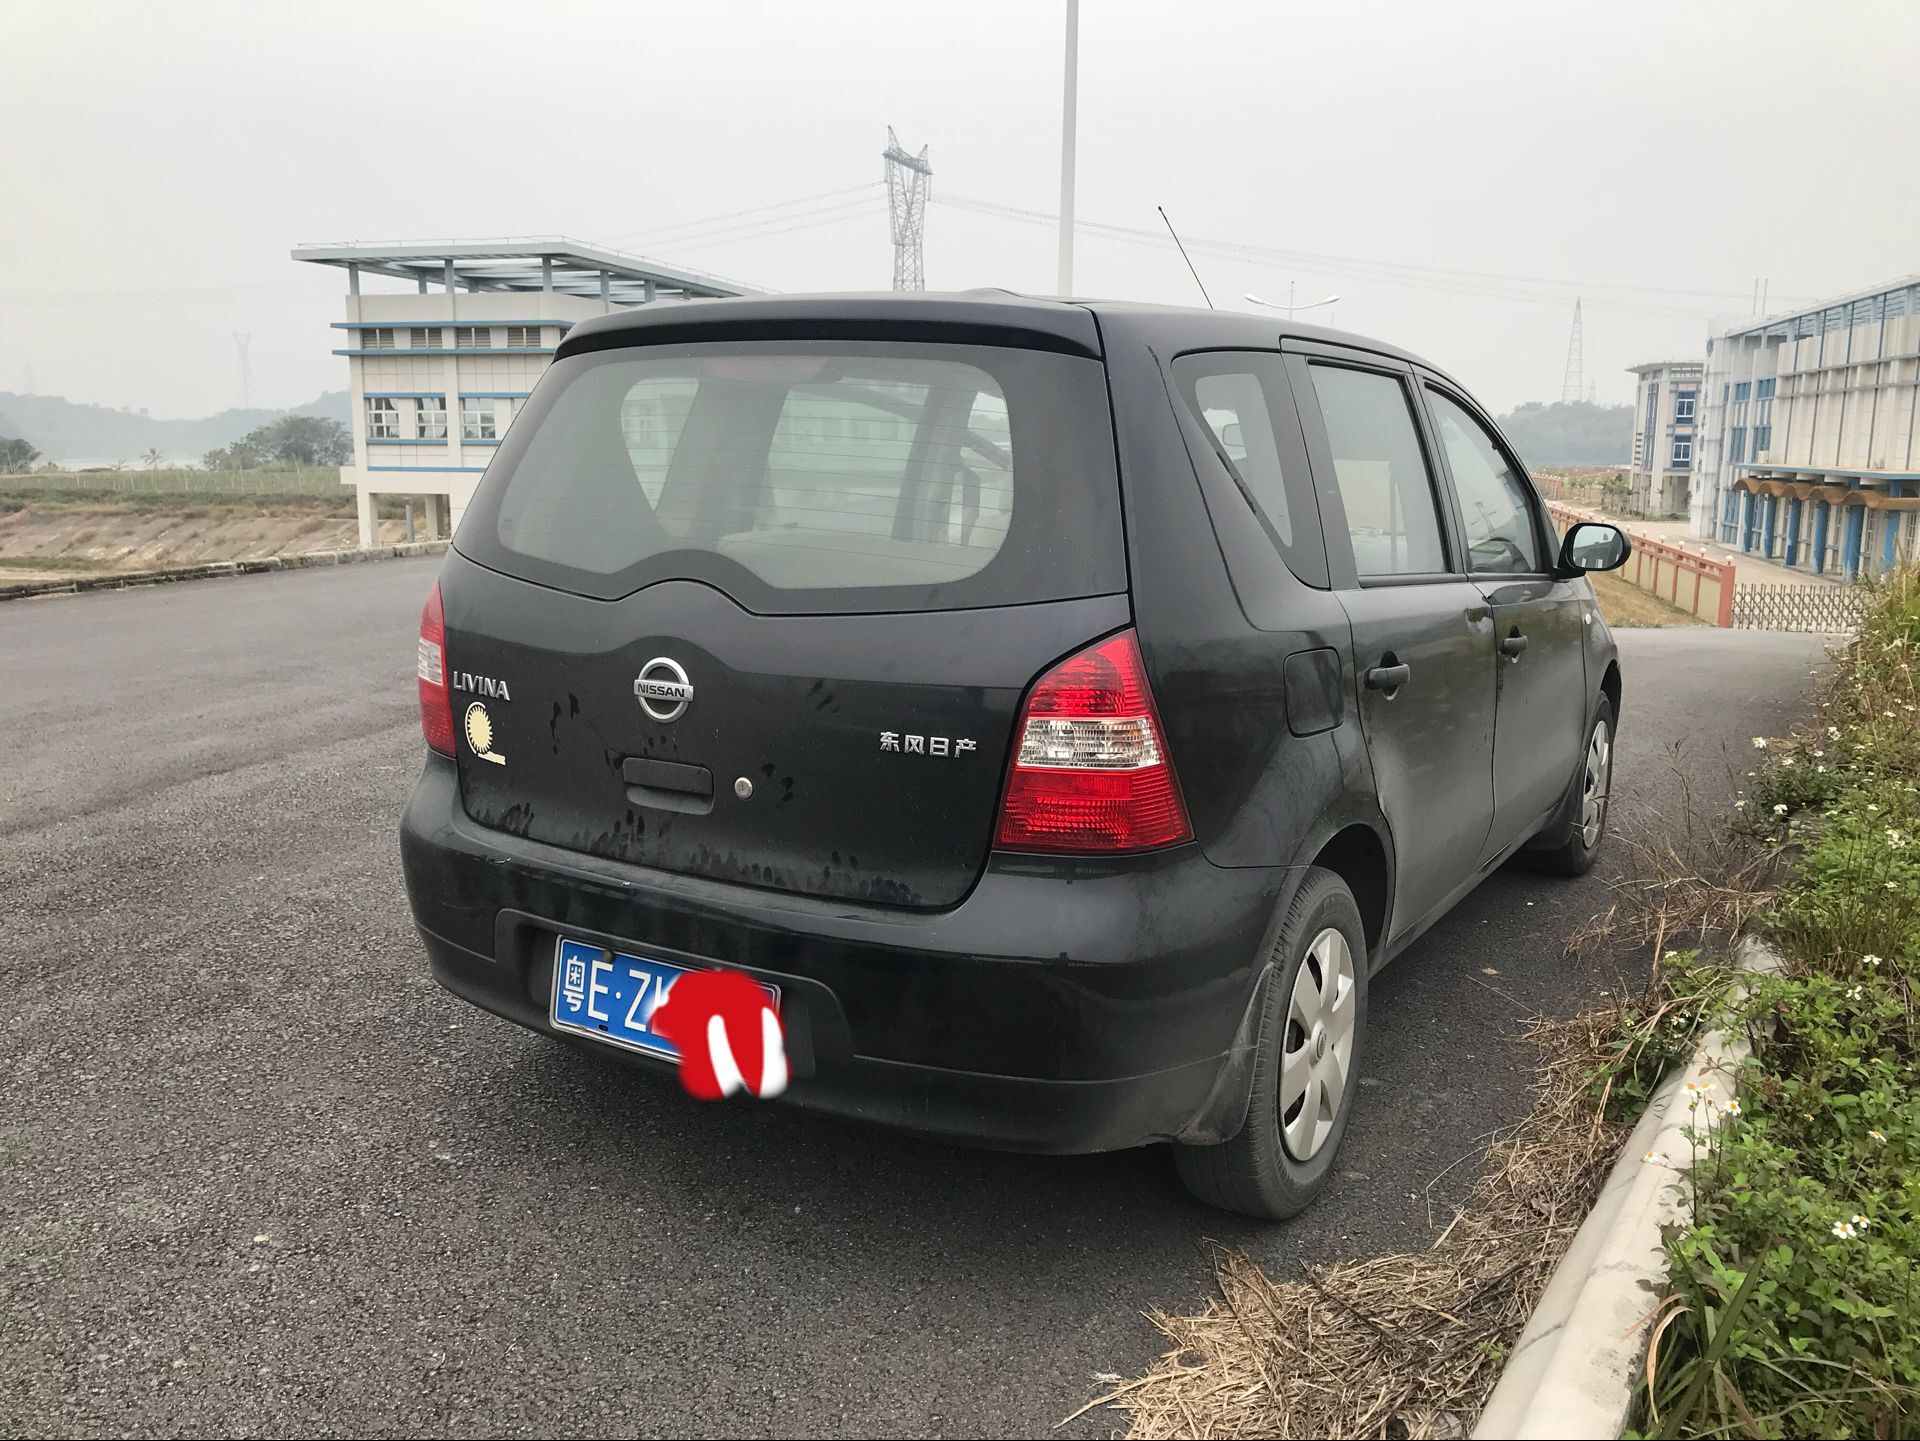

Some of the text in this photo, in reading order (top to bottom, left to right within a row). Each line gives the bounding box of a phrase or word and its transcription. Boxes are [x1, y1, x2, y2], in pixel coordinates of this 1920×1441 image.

[453, 670, 511, 701] LIVINA
[637, 683, 685, 698] NISSAN
[879, 731, 977, 759] 东风日产
[562, 955, 669, 1034] 粤E·Z
